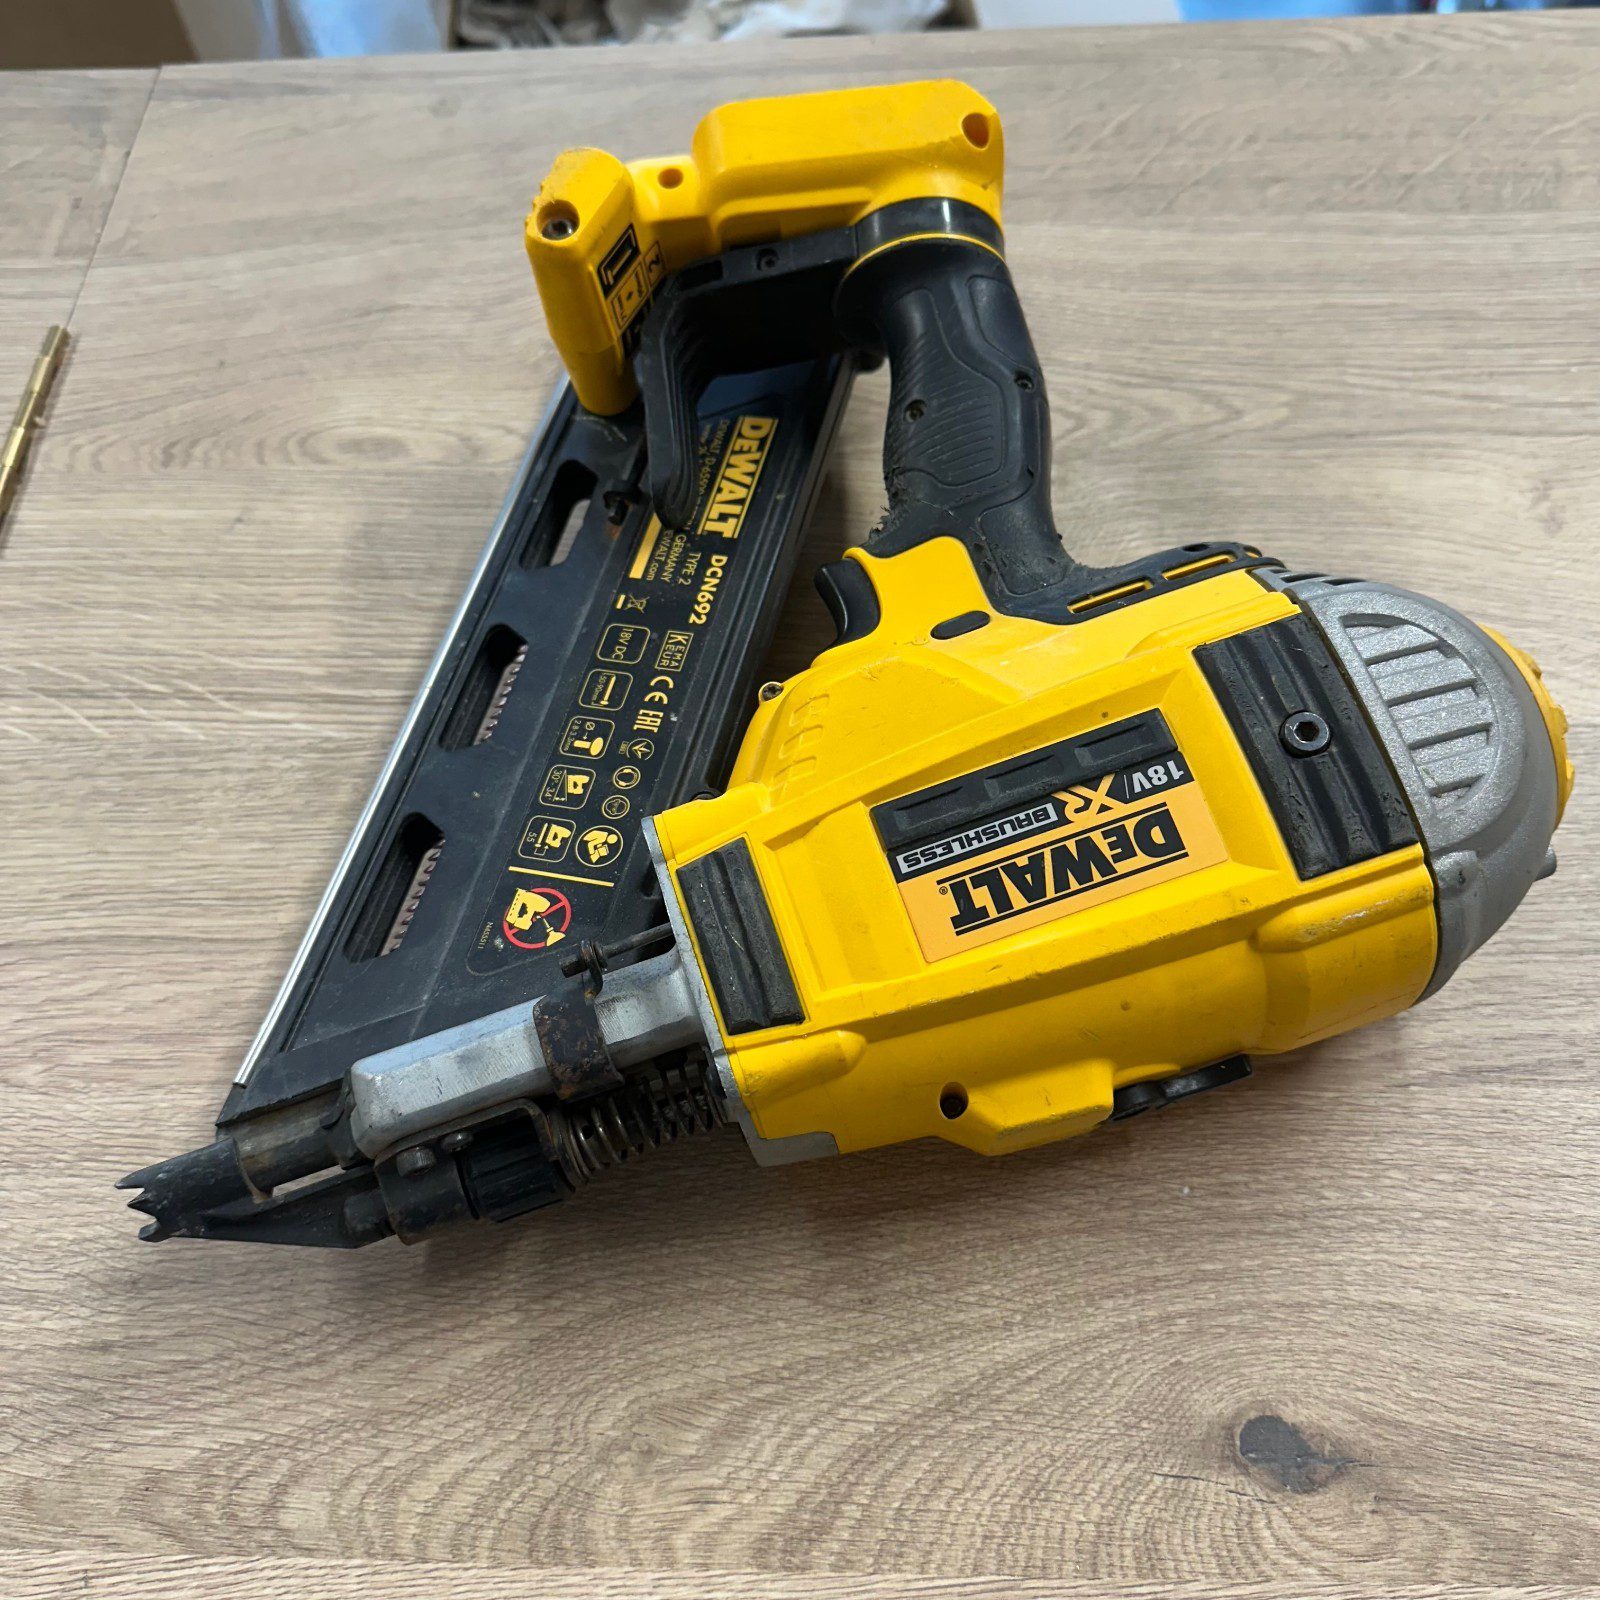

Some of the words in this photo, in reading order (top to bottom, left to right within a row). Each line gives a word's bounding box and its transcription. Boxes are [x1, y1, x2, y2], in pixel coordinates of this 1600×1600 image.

[646, 530, 674, 581] EWALT.com
[661, 534, 687, 582] GERMANY
[681, 552, 702, 576] TYPE
[678, 577, 691, 586] 2
[688, 554, 729, 625] DCN692
[618, 628, 634, 645] 18V
[611, 646, 627, 660] DC
[644, 675, 674, 705] CE
[527, 831, 538, 843] 55
[902, 805, 1052, 869] BRUSHLESS
